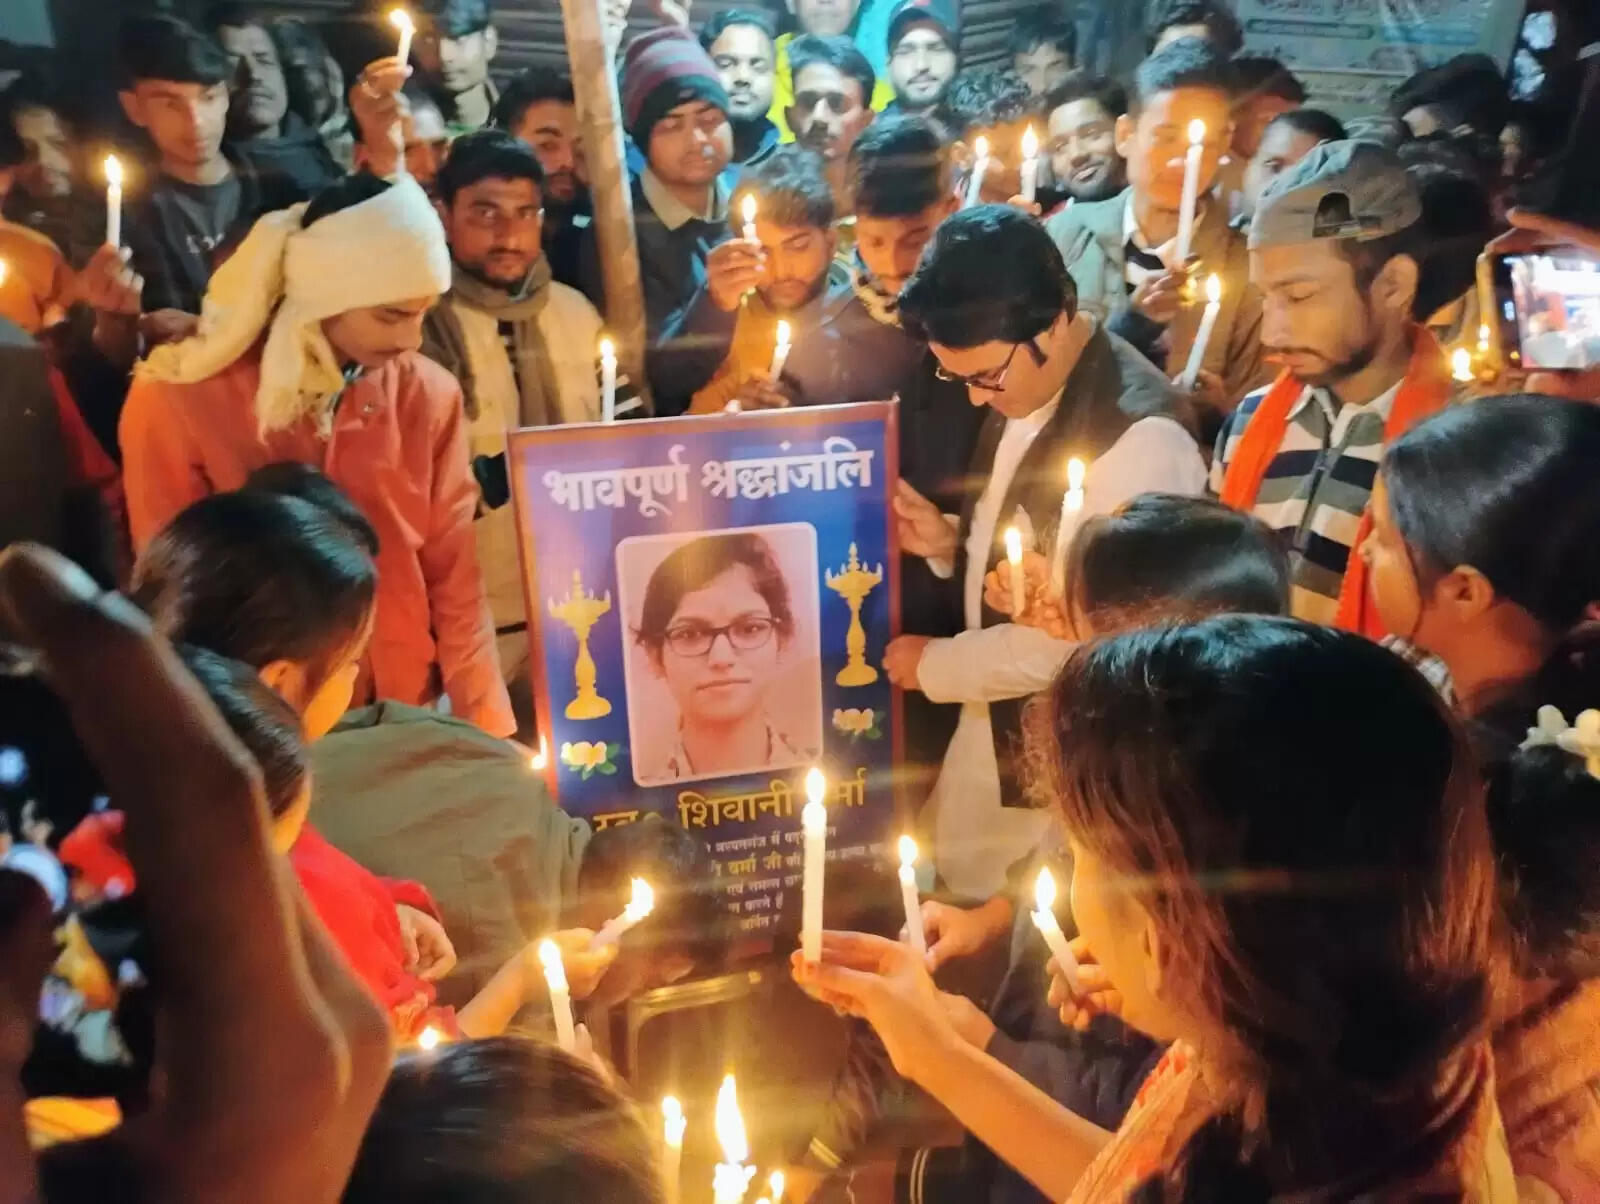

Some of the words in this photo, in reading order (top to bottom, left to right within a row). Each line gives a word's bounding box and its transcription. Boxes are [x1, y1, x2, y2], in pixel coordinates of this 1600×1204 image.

[541, 445, 690, 517] भावपूर्ण
[701, 436, 874, 499] श्रद्धांजलि
[678, 779, 793, 829] शिवानी
